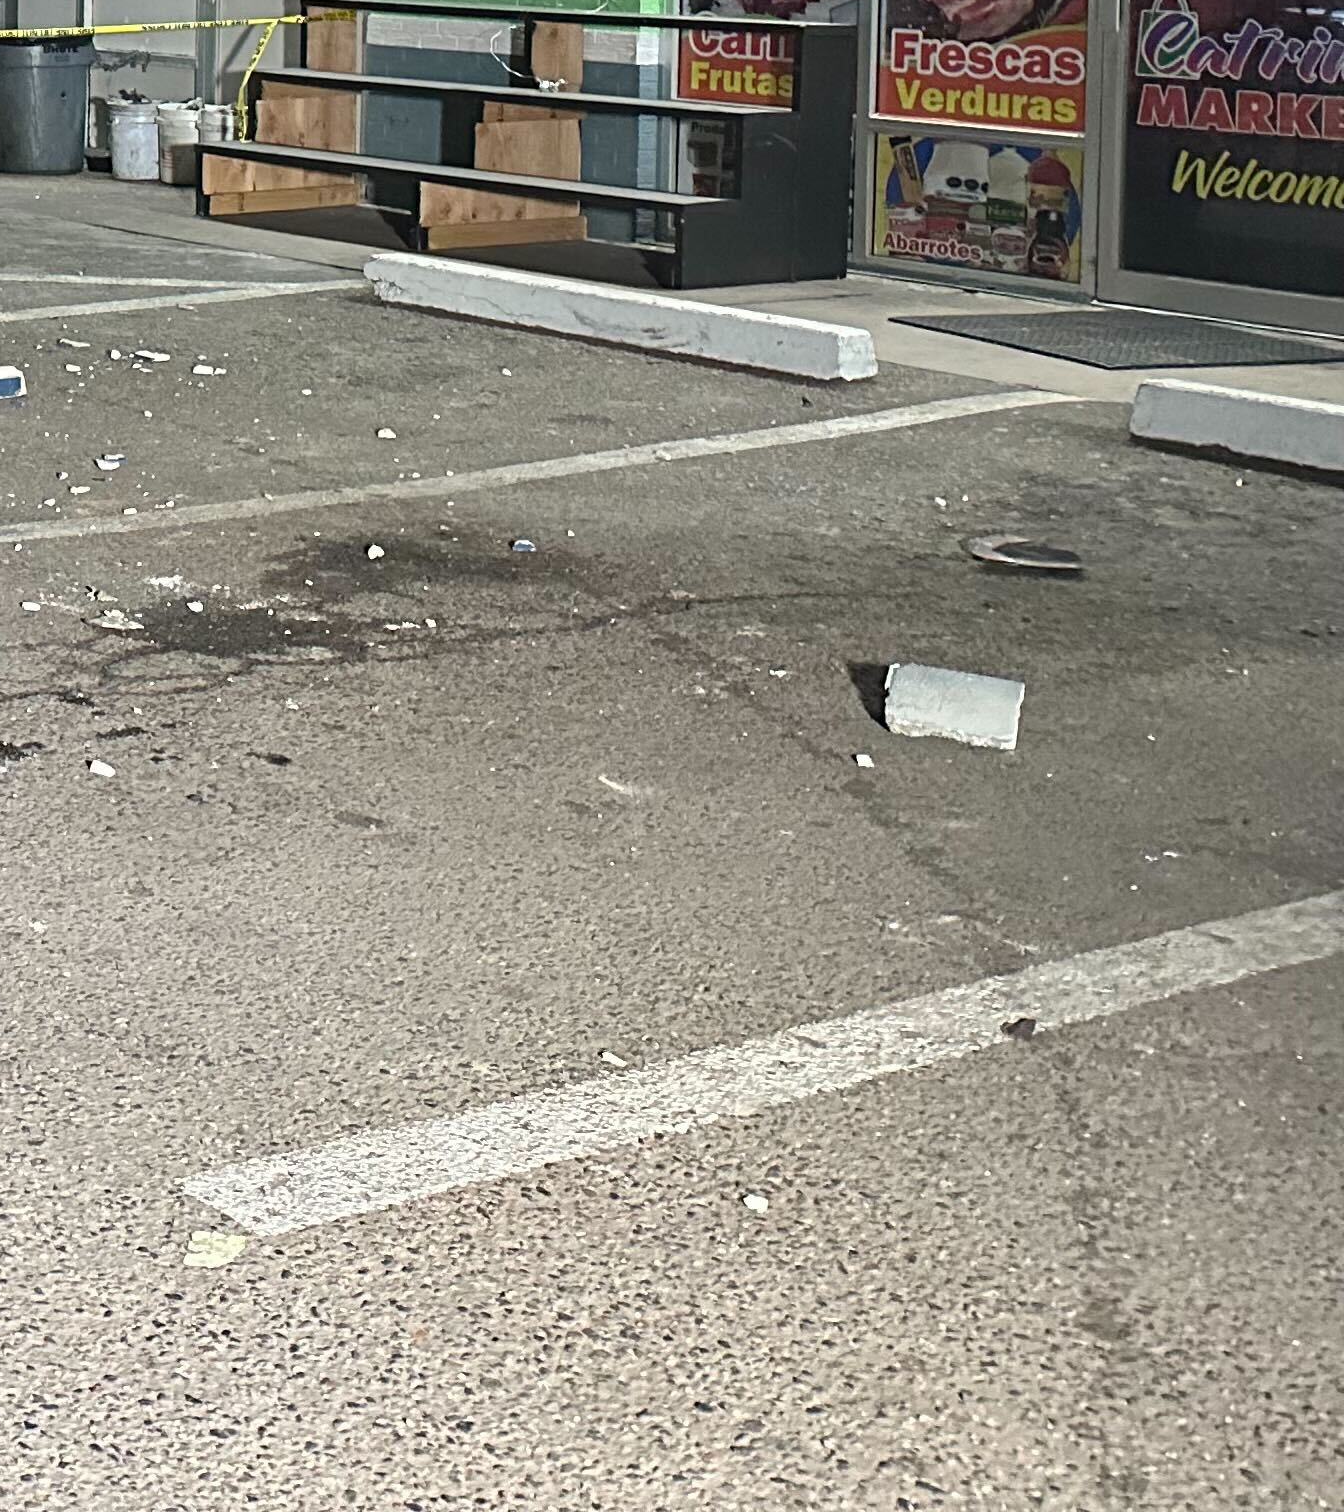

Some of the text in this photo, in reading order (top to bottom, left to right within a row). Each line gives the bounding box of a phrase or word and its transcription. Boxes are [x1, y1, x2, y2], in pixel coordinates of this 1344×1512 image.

[893, 30, 1085, 84] Frescas
[690, 61, 794, 99] Frutas
[896, 78, 1077, 123] Verduras
[883, 230, 984, 263] Abarrotes
